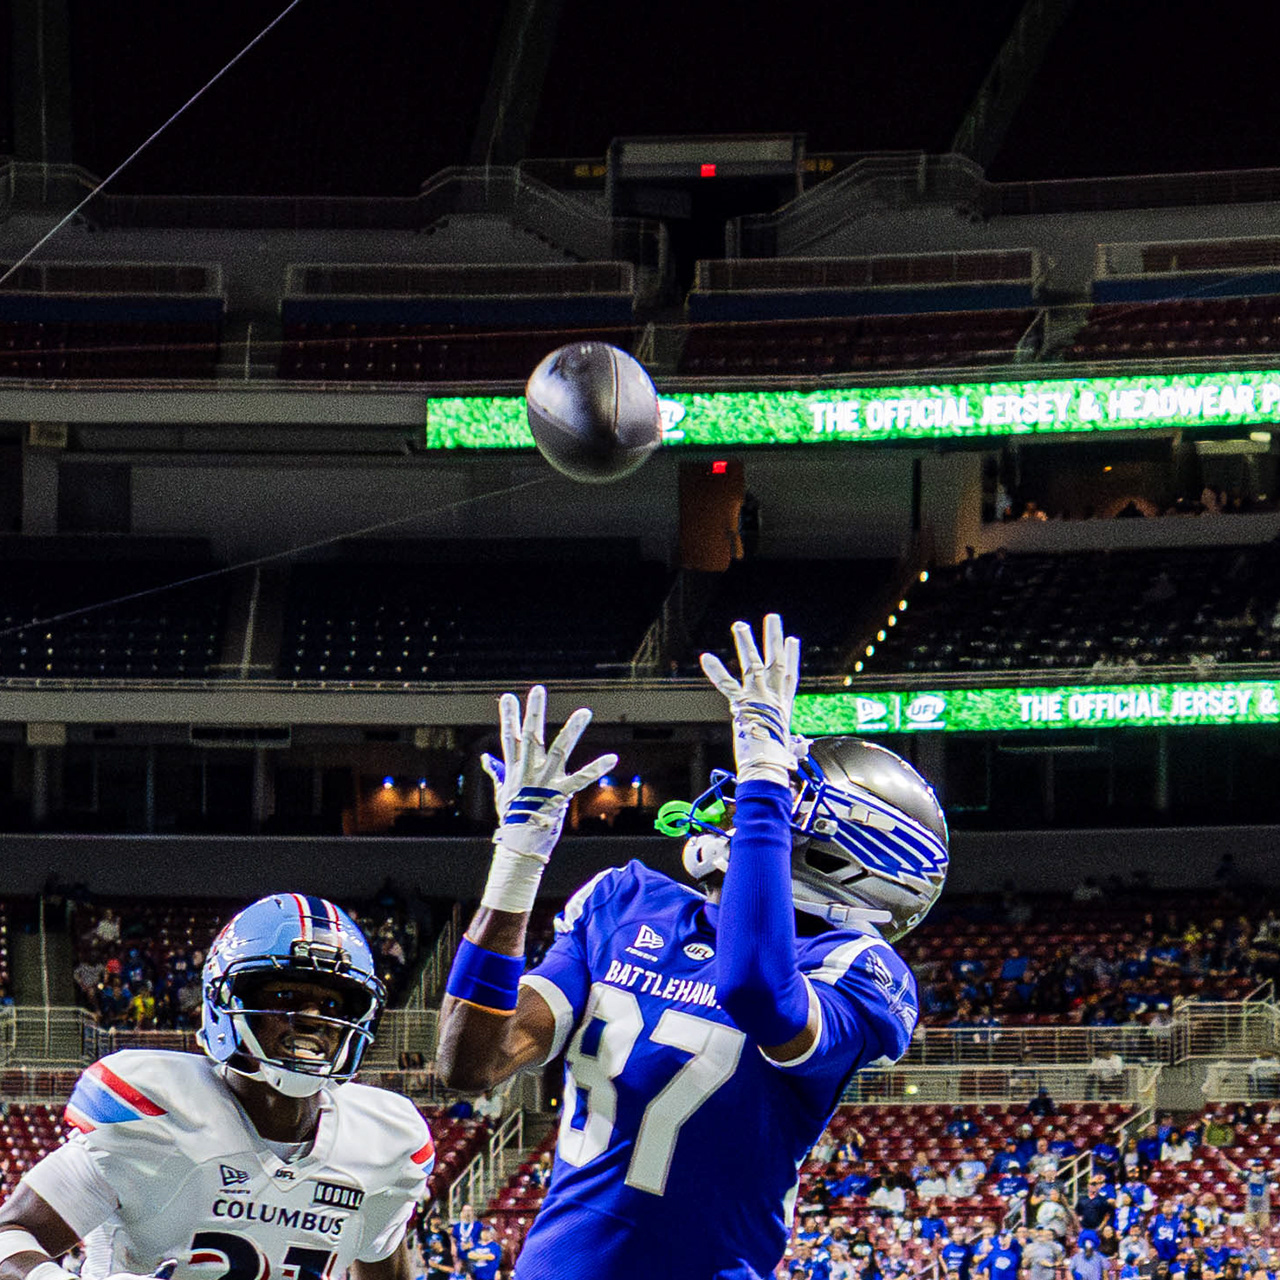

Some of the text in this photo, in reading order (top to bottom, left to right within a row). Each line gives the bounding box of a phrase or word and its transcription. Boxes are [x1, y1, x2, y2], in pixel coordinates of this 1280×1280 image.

[809, 402, 859, 432] THE
[867, 397, 973, 431] OFFICIAL
[980, 392, 1071, 424] JERSEY
[1079, 393, 1101, 421] &
[1108, 386, 1254, 419] HEADWEAR
[1018, 695, 1063, 722] THE
[1068, 693, 1166, 720] OFFICIAL
[1170, 690, 1251, 716] JERSEY
[1259, 689, 1277, 714] &
[604, 960, 721, 1008] BATTLEHAW
[560, 981, 747, 1197] 87
[275, 1168, 297, 1180] UFL
[212, 1198, 345, 1236] COLUMBUS
